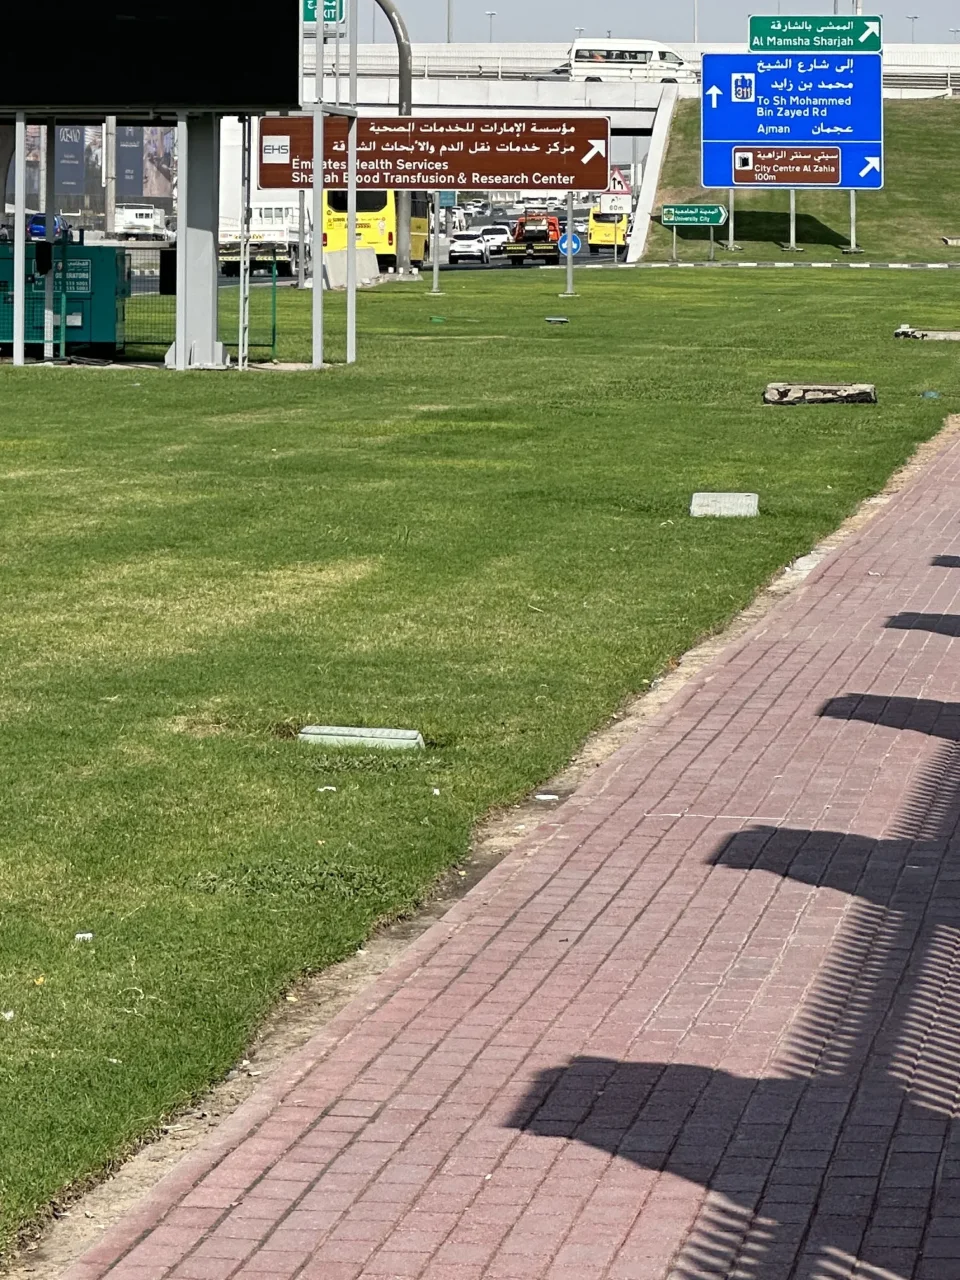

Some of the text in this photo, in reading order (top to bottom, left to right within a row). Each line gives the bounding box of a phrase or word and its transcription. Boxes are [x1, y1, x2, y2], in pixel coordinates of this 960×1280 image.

[770, 20, 854, 33] الممشى بالشارقة
[752, 36, 854, 48] Al Mamsha Sharjah
[756, 58, 854, 73] إلى شارع الشيخ
[771, 78, 854, 92] محمد بن زايد
[736, 87, 751, 98] 311
[756, 96, 852, 106] To Sh Mohammed
[756, 107, 828, 119] Bin Zayed Rd
[369, 122, 576, 137] مؤسسة الإمارات للخدمات الصحية
[756, 124, 791, 135] Ajman
[811, 122, 854, 135] عجمان
[263, 144, 289, 154] EHS
[380, 140, 435, 154] والأبحاث
[440, 141, 464, 156] الدم
[468, 141, 491, 154] نقل
[495, 141, 541, 153] خدمات
[545, 141, 575, 154] مركز
[756, 151, 839, 163] سيتي سنتر الزاهية
[396, 159, 449, 170] Services
[754, 164, 835, 174] City Centre Al Zahia
[291, 172, 575, 184] Shaah Bood Transfusion & Research Center
[754, 173, 776, 181] 100m
